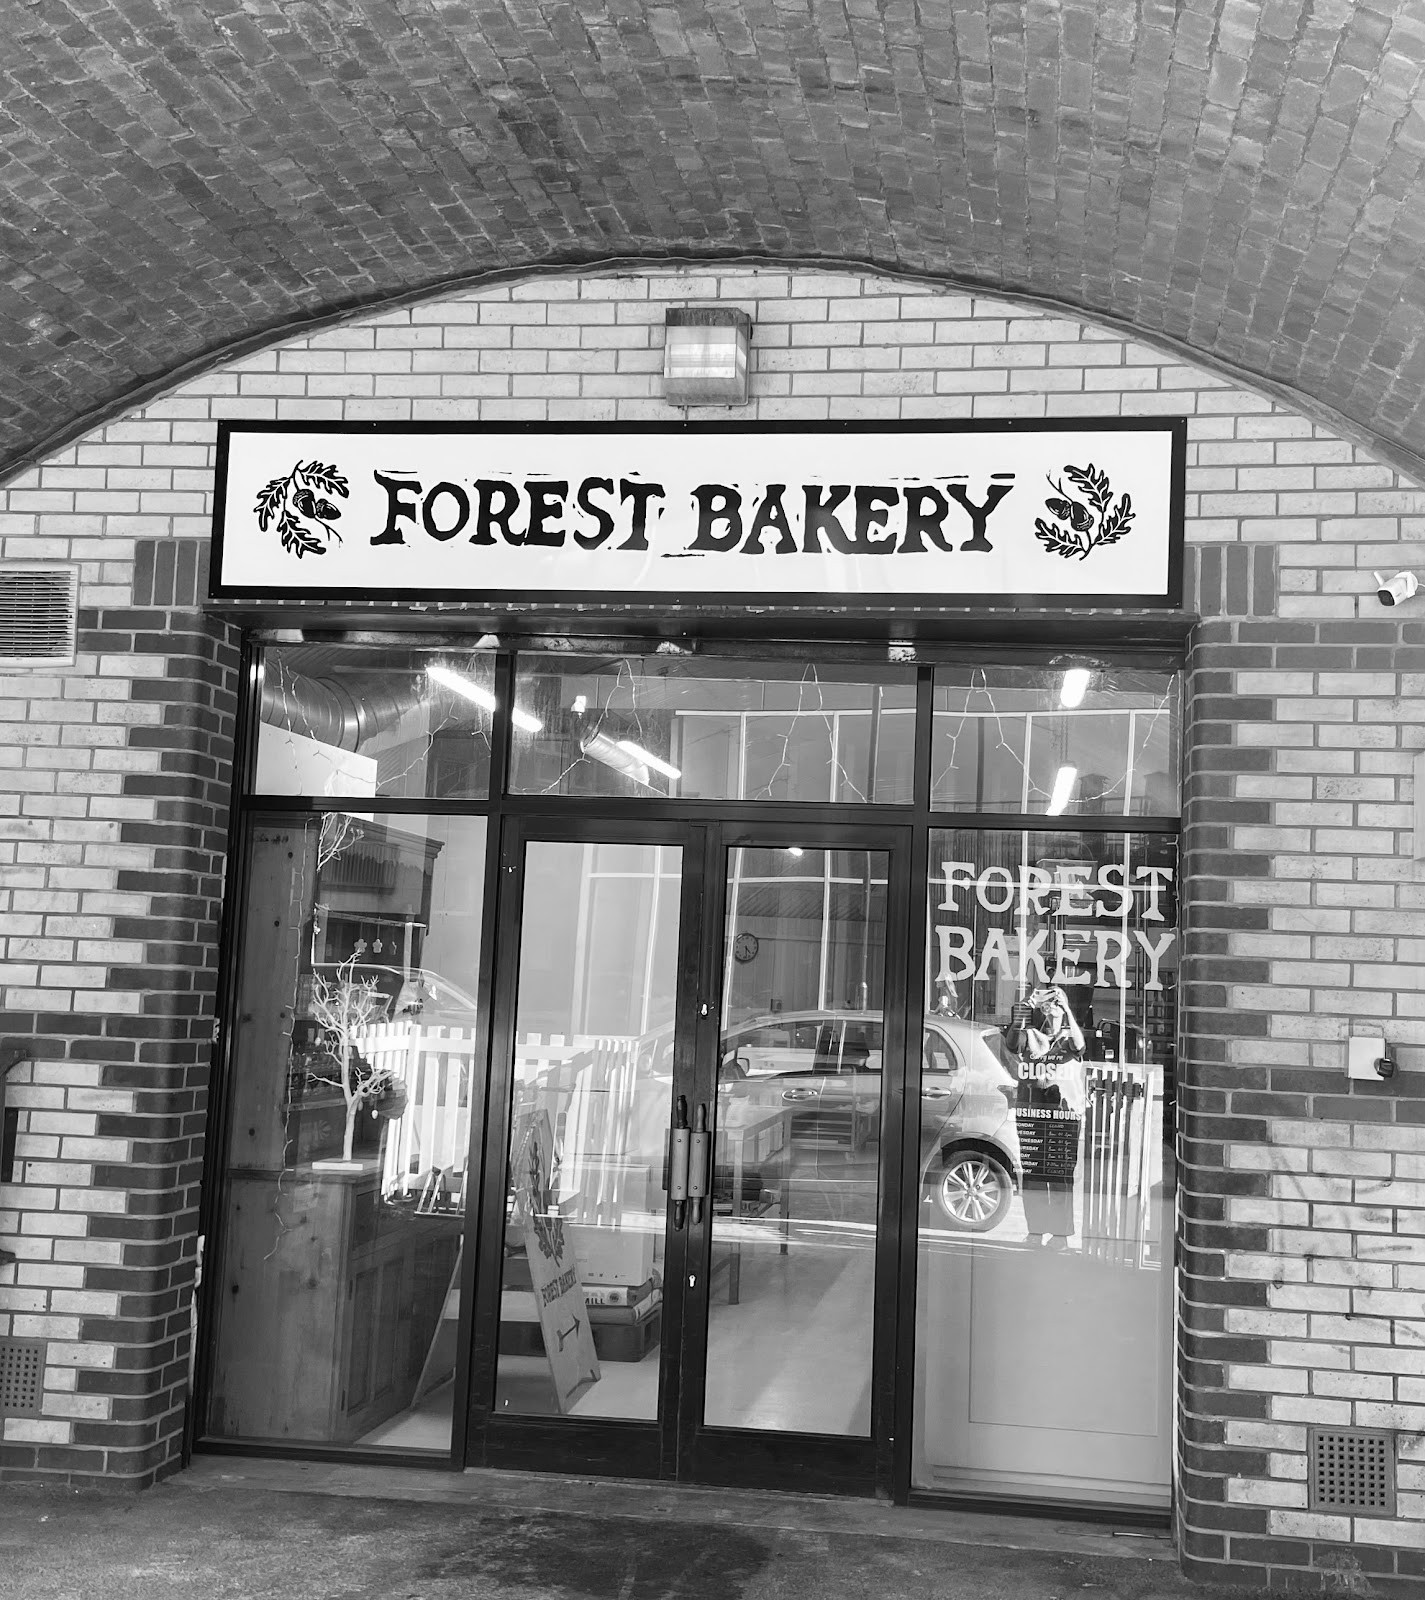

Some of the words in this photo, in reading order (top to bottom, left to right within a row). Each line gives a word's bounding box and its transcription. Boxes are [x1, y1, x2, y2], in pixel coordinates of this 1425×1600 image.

[370, 470, 666, 551] FOREST
[686, 474, 1015, 554] BAKERY
[937, 861, 1173, 922] FOREST
[935, 925, 1176, 991] BAKERY
[1053, 1110, 1081, 1121] HOURS
